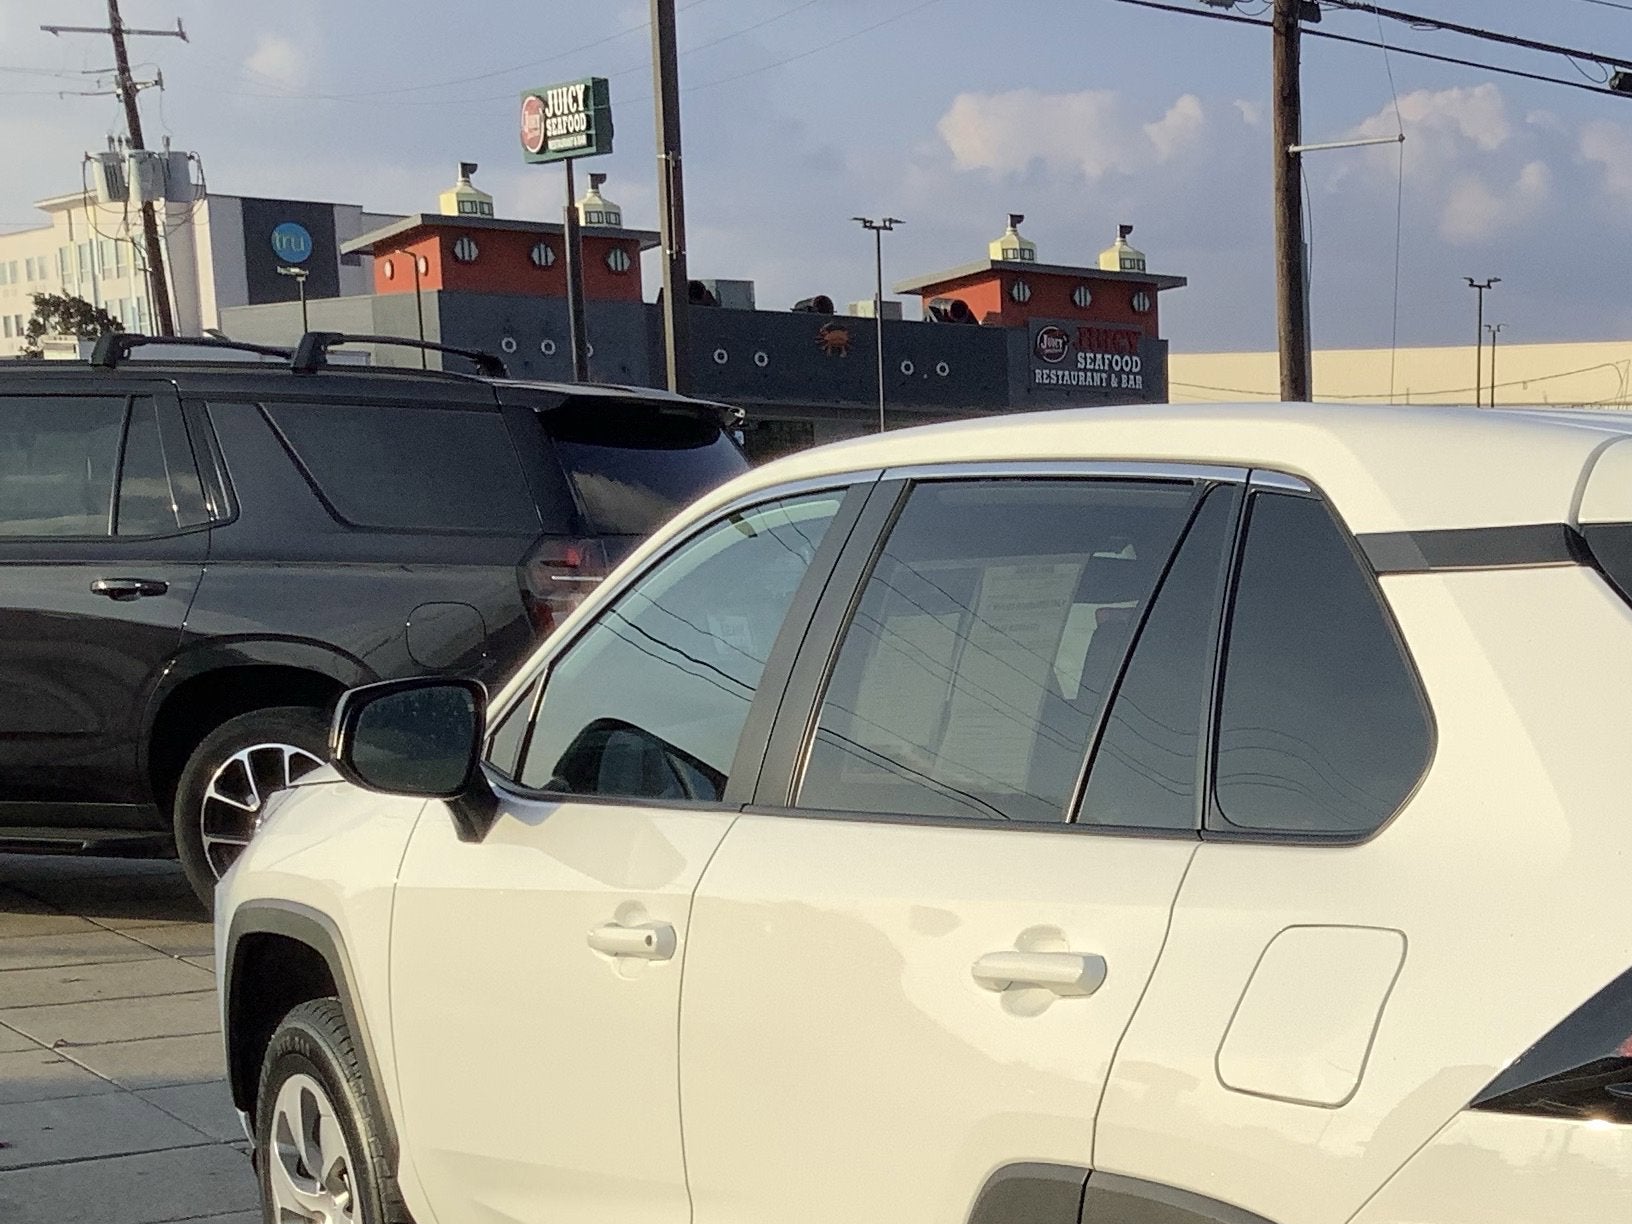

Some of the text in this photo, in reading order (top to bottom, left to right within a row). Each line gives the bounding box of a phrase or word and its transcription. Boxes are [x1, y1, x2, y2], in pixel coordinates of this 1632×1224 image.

[545, 84, 585, 117] JUICY
[546, 112, 587, 137] SEAFOOD
[273, 231, 305, 252] tru
[1077, 352, 1141, 373] SEAFOOD
[1035, 369, 1143, 389] RESTAURANT & BAR
